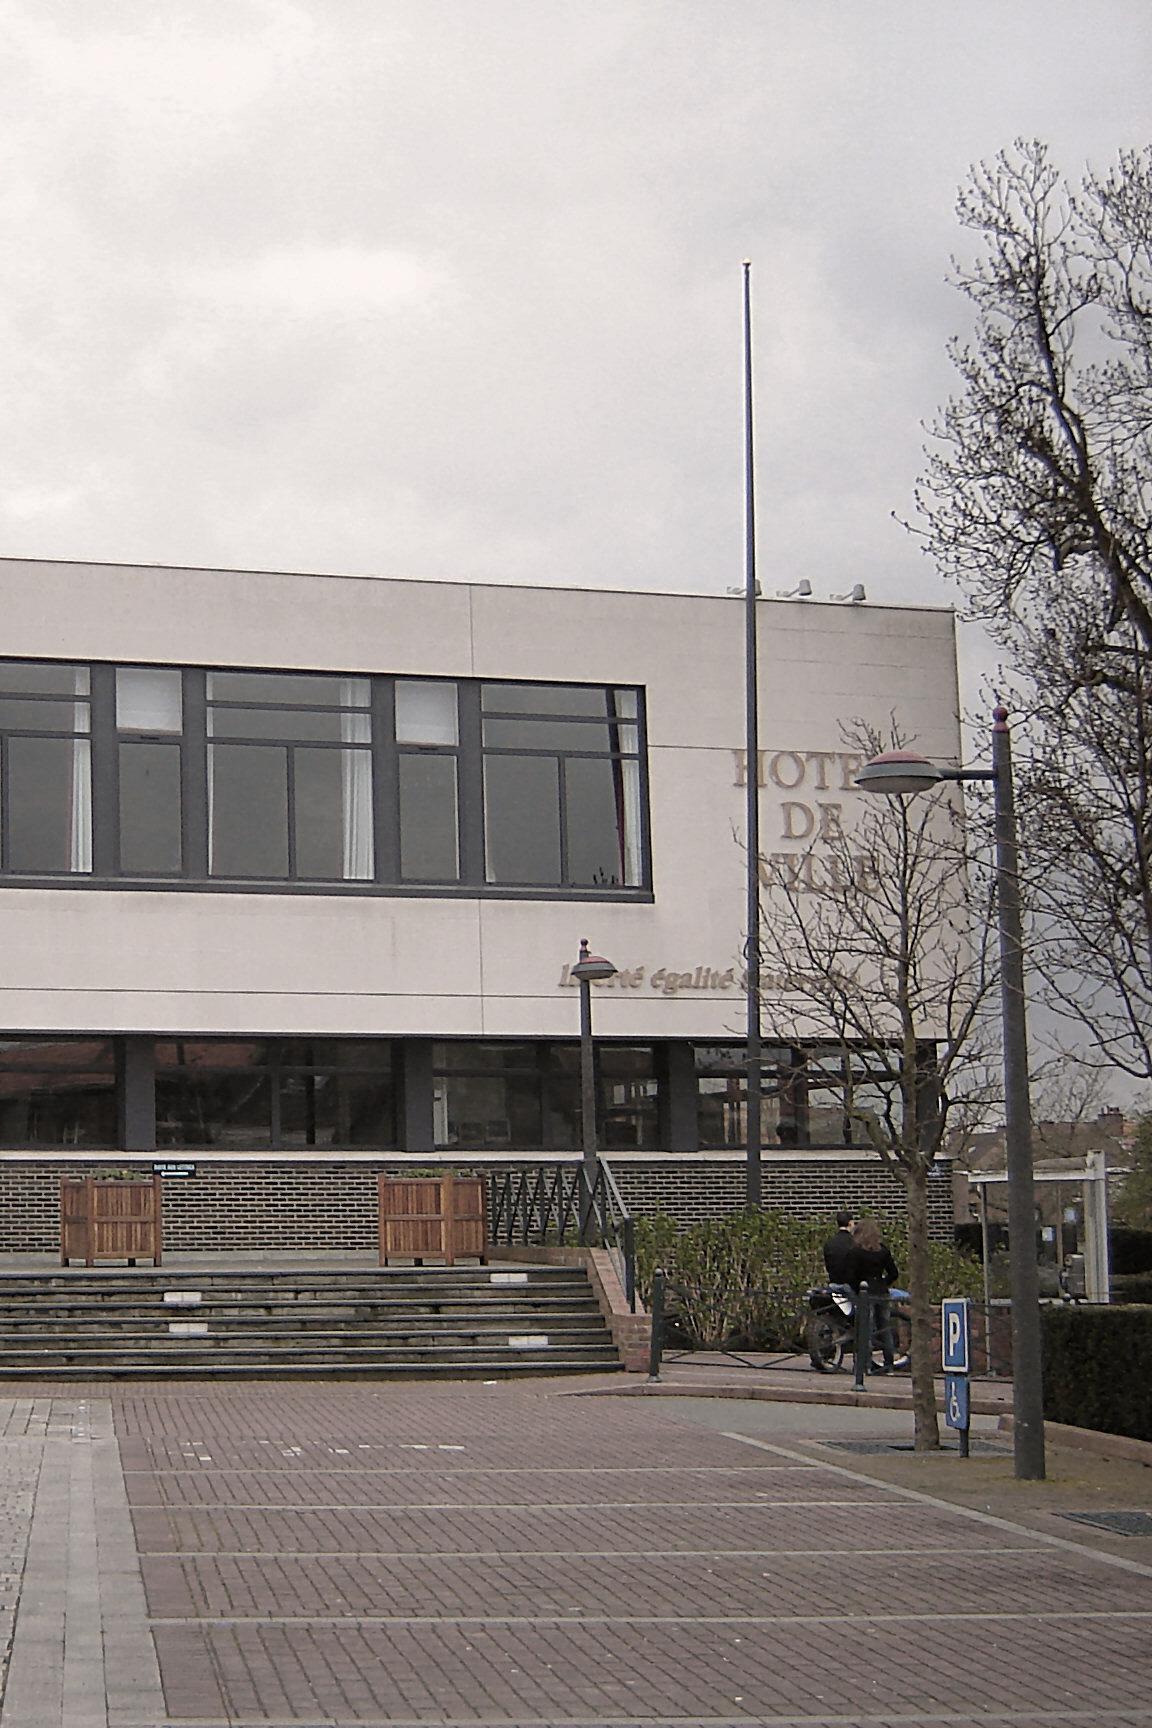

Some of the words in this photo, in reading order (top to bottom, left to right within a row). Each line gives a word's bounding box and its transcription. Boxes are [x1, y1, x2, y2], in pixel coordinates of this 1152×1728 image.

[733, 749, 868, 791] HOTE
[780, 801, 843, 841] DE
[650, 966, 734, 995] égalité
[949, 1312, 960, 1356] P
